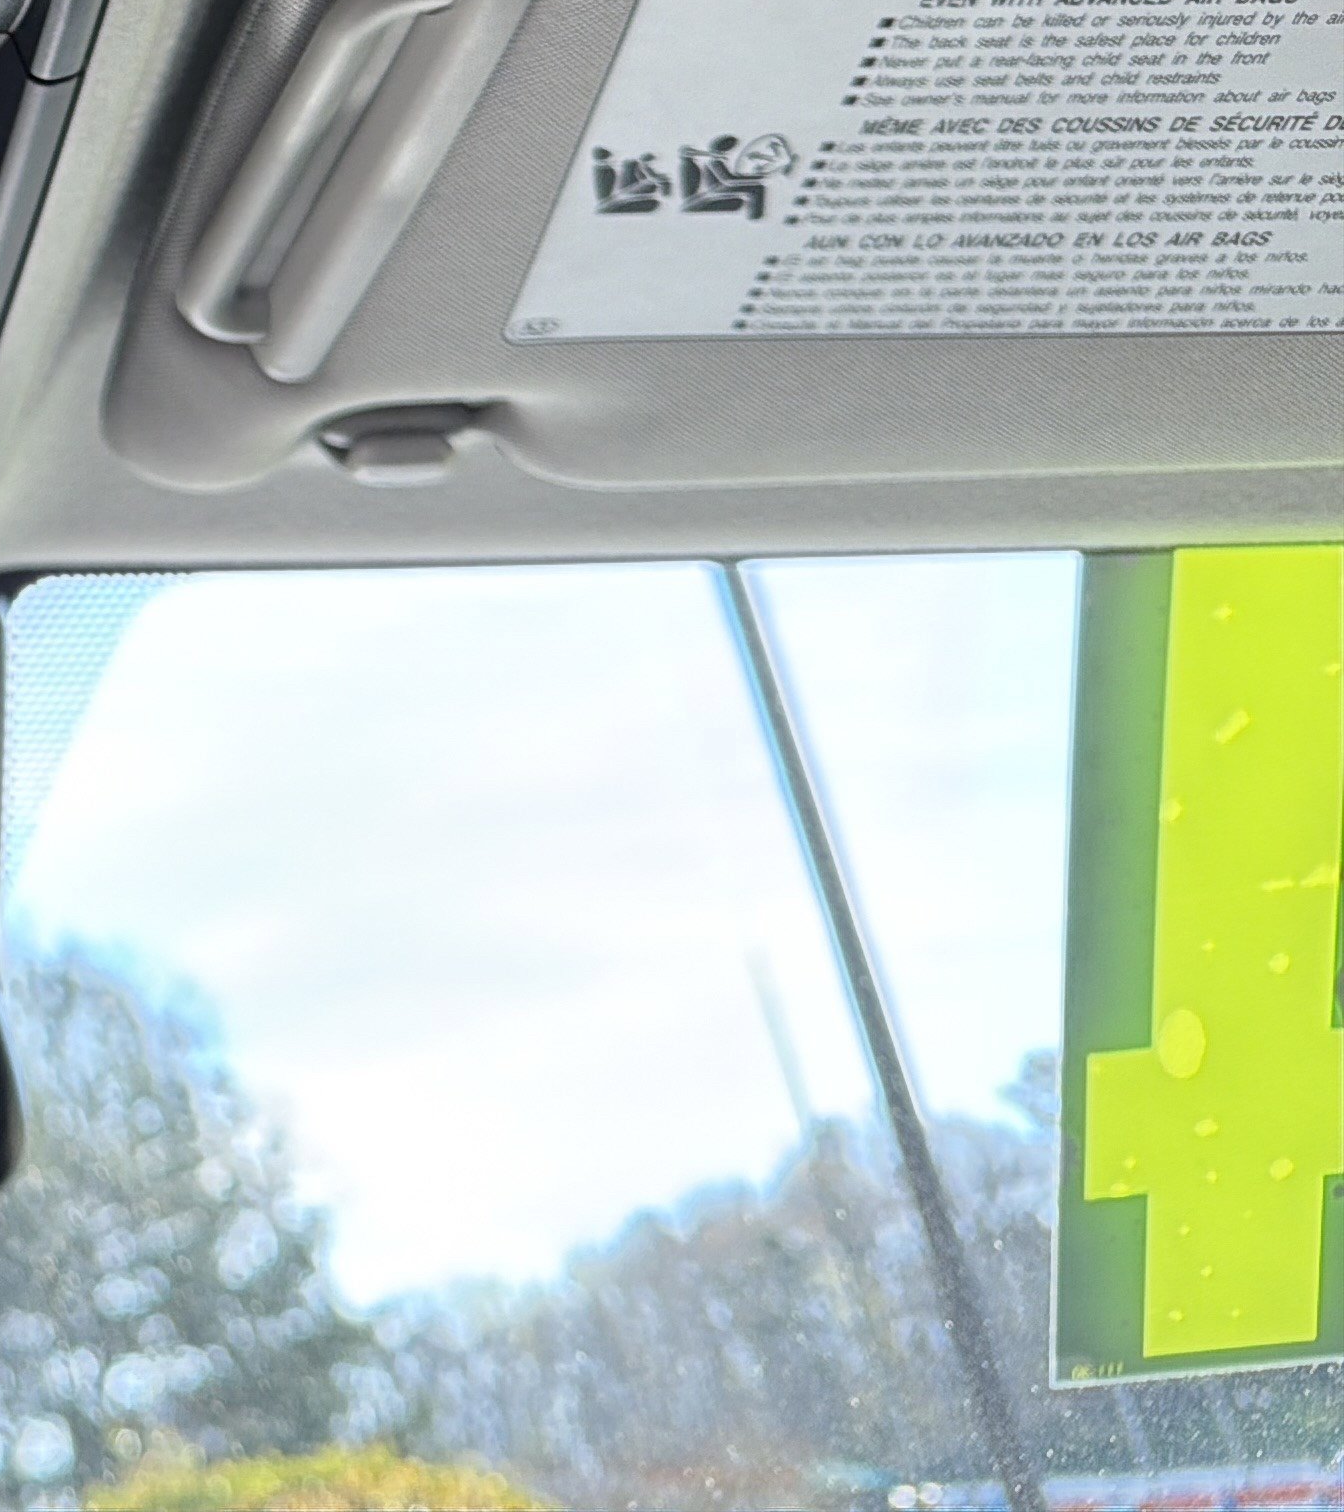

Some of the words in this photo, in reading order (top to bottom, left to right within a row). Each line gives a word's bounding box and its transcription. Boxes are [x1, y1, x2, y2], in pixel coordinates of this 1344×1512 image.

[897, 15, 967, 30] Children
[972, 18, 1004, 29] can
[1011, 15, 1035, 28] be
[1042, 13, 1086, 27] killed
[1091, 16, 1110, 27] or
[1116, 13, 1189, 30] seriously
[1197, 12, 1256, 29] injured
[1262, 12, 1284, 29] by
[1291, 11, 1319, 26] the
[891, 36, 921, 49] The
[928, 35, 968, 49] back
[974, 36, 1012, 48] seat
[1018, 34, 1034, 48] is
[1041, 34, 1071, 47] the
[1074, 33, 1126, 47] safest
[1130, 33, 1177, 49] place
[1184, 32, 1209, 46] for
[1215, 32, 1282, 46] children
[1081, 53, 1122, 66] child
[1128, 53, 1166, 66] seat
[1171, 53, 1188, 66] in
[1195, 52, 1223, 65] the
[1230, 51, 1271, 65] front
[1013, 72, 1054, 86] belts
[1061, 72, 1094, 86] and
[1100, 71, 1140, 85] child
[1146, 71, 1222, 84] restraints
[1066, 92, 1109, 104] more
[1115, 91, 1206, 104] information
[1213, 90, 1262, 103] about
[1267, 90, 1291, 103] air
[1296, 90, 1336, 105] bags
[929, 118, 991, 134] AVEC
[996, 117, 1044, 134] DES
[1050, 116, 1162, 133] COUSSINS
[1169, 116, 1203, 133] DE
[1209, 111, 1318, 132] SÉCURITÉ
[1072, 232, 1105, 248] EN
[1112, 231, 1161, 248] LOS
[1164, 231, 1205, 247] AIR
[1211, 230, 1274, 247] BAGS
